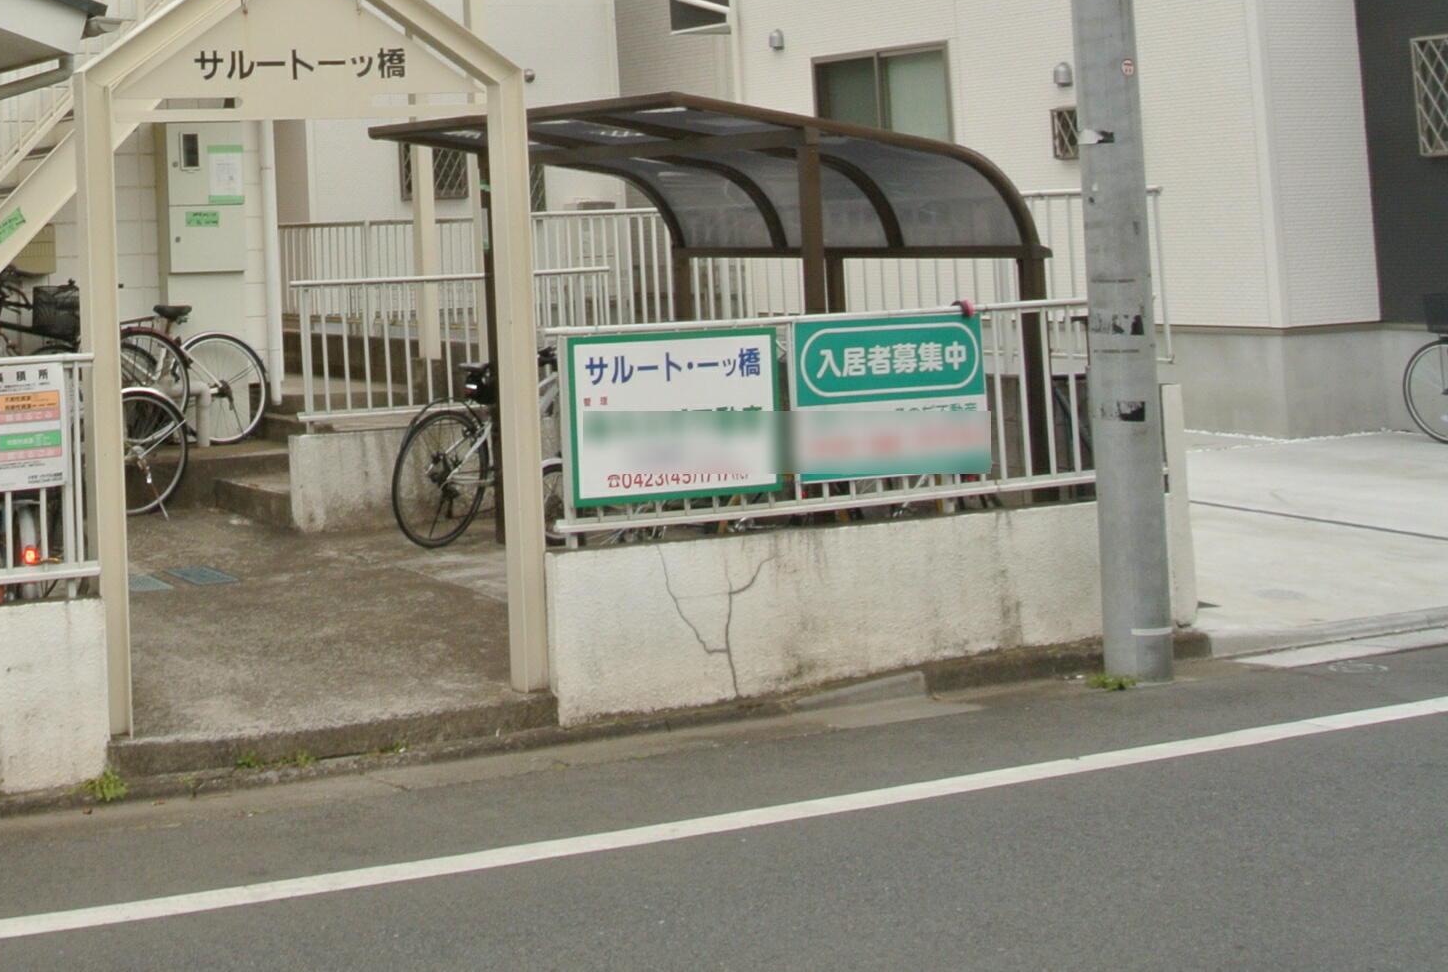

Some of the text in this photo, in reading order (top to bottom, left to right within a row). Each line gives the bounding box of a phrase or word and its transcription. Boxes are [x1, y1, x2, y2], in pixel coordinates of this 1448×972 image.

[816, 339, 967, 379] 入居者募集中
